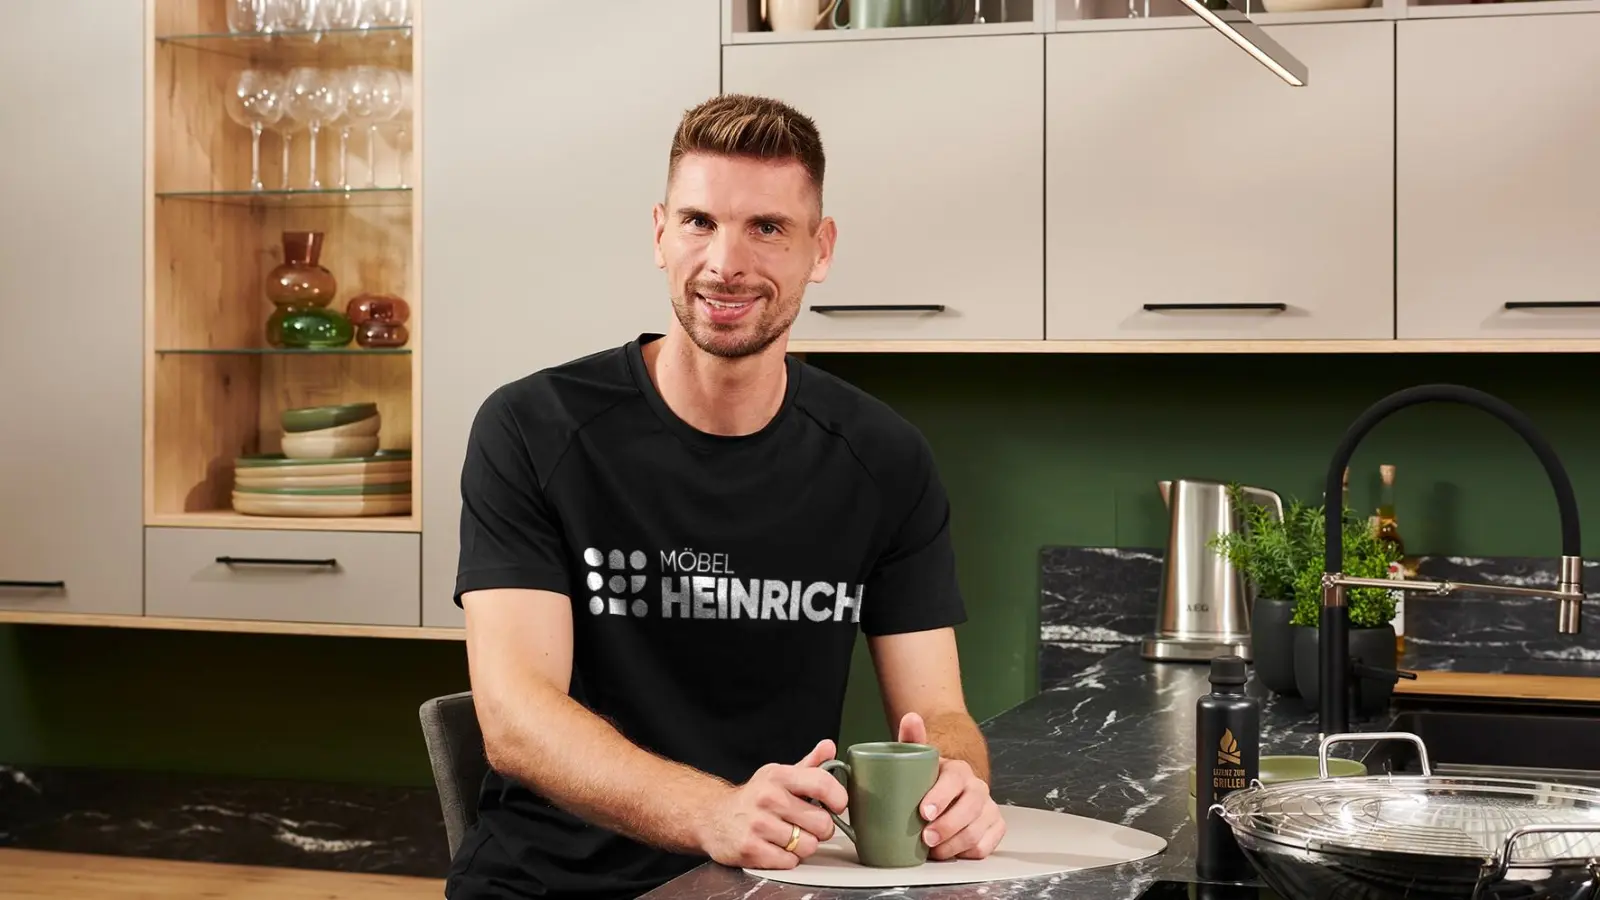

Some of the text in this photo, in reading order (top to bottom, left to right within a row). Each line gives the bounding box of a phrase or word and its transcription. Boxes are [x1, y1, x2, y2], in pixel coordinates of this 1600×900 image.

[660, 548, 735, 575] MÖBEL
[661, 575, 864, 623] HEINRICH
[1186, 603, 1209, 612] AEG
[1213, 777, 1245, 788] GRILLEN
